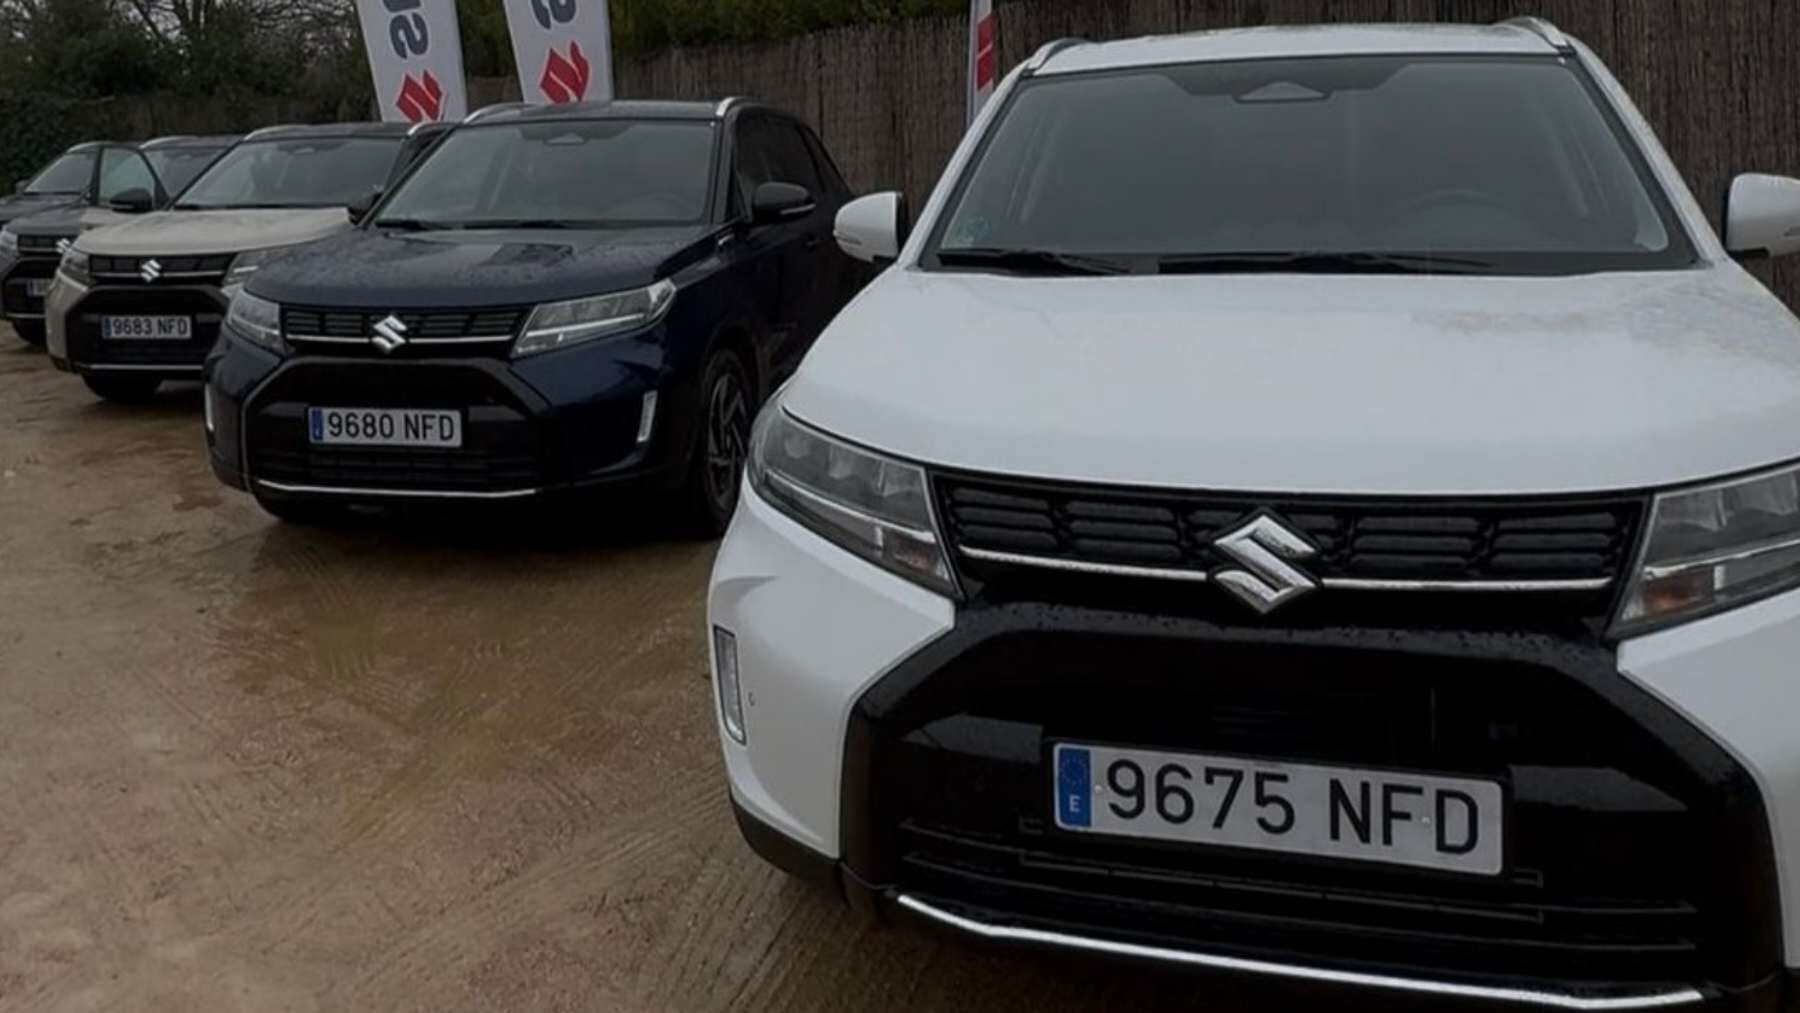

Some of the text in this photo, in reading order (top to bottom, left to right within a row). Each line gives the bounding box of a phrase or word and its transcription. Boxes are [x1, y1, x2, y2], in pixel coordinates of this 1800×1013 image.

[112, 317, 188, 336] 9683 NFD
[328, 412, 454, 441] 9680 NFD
[1069, 759, 1478, 855] E 9675 NFD
